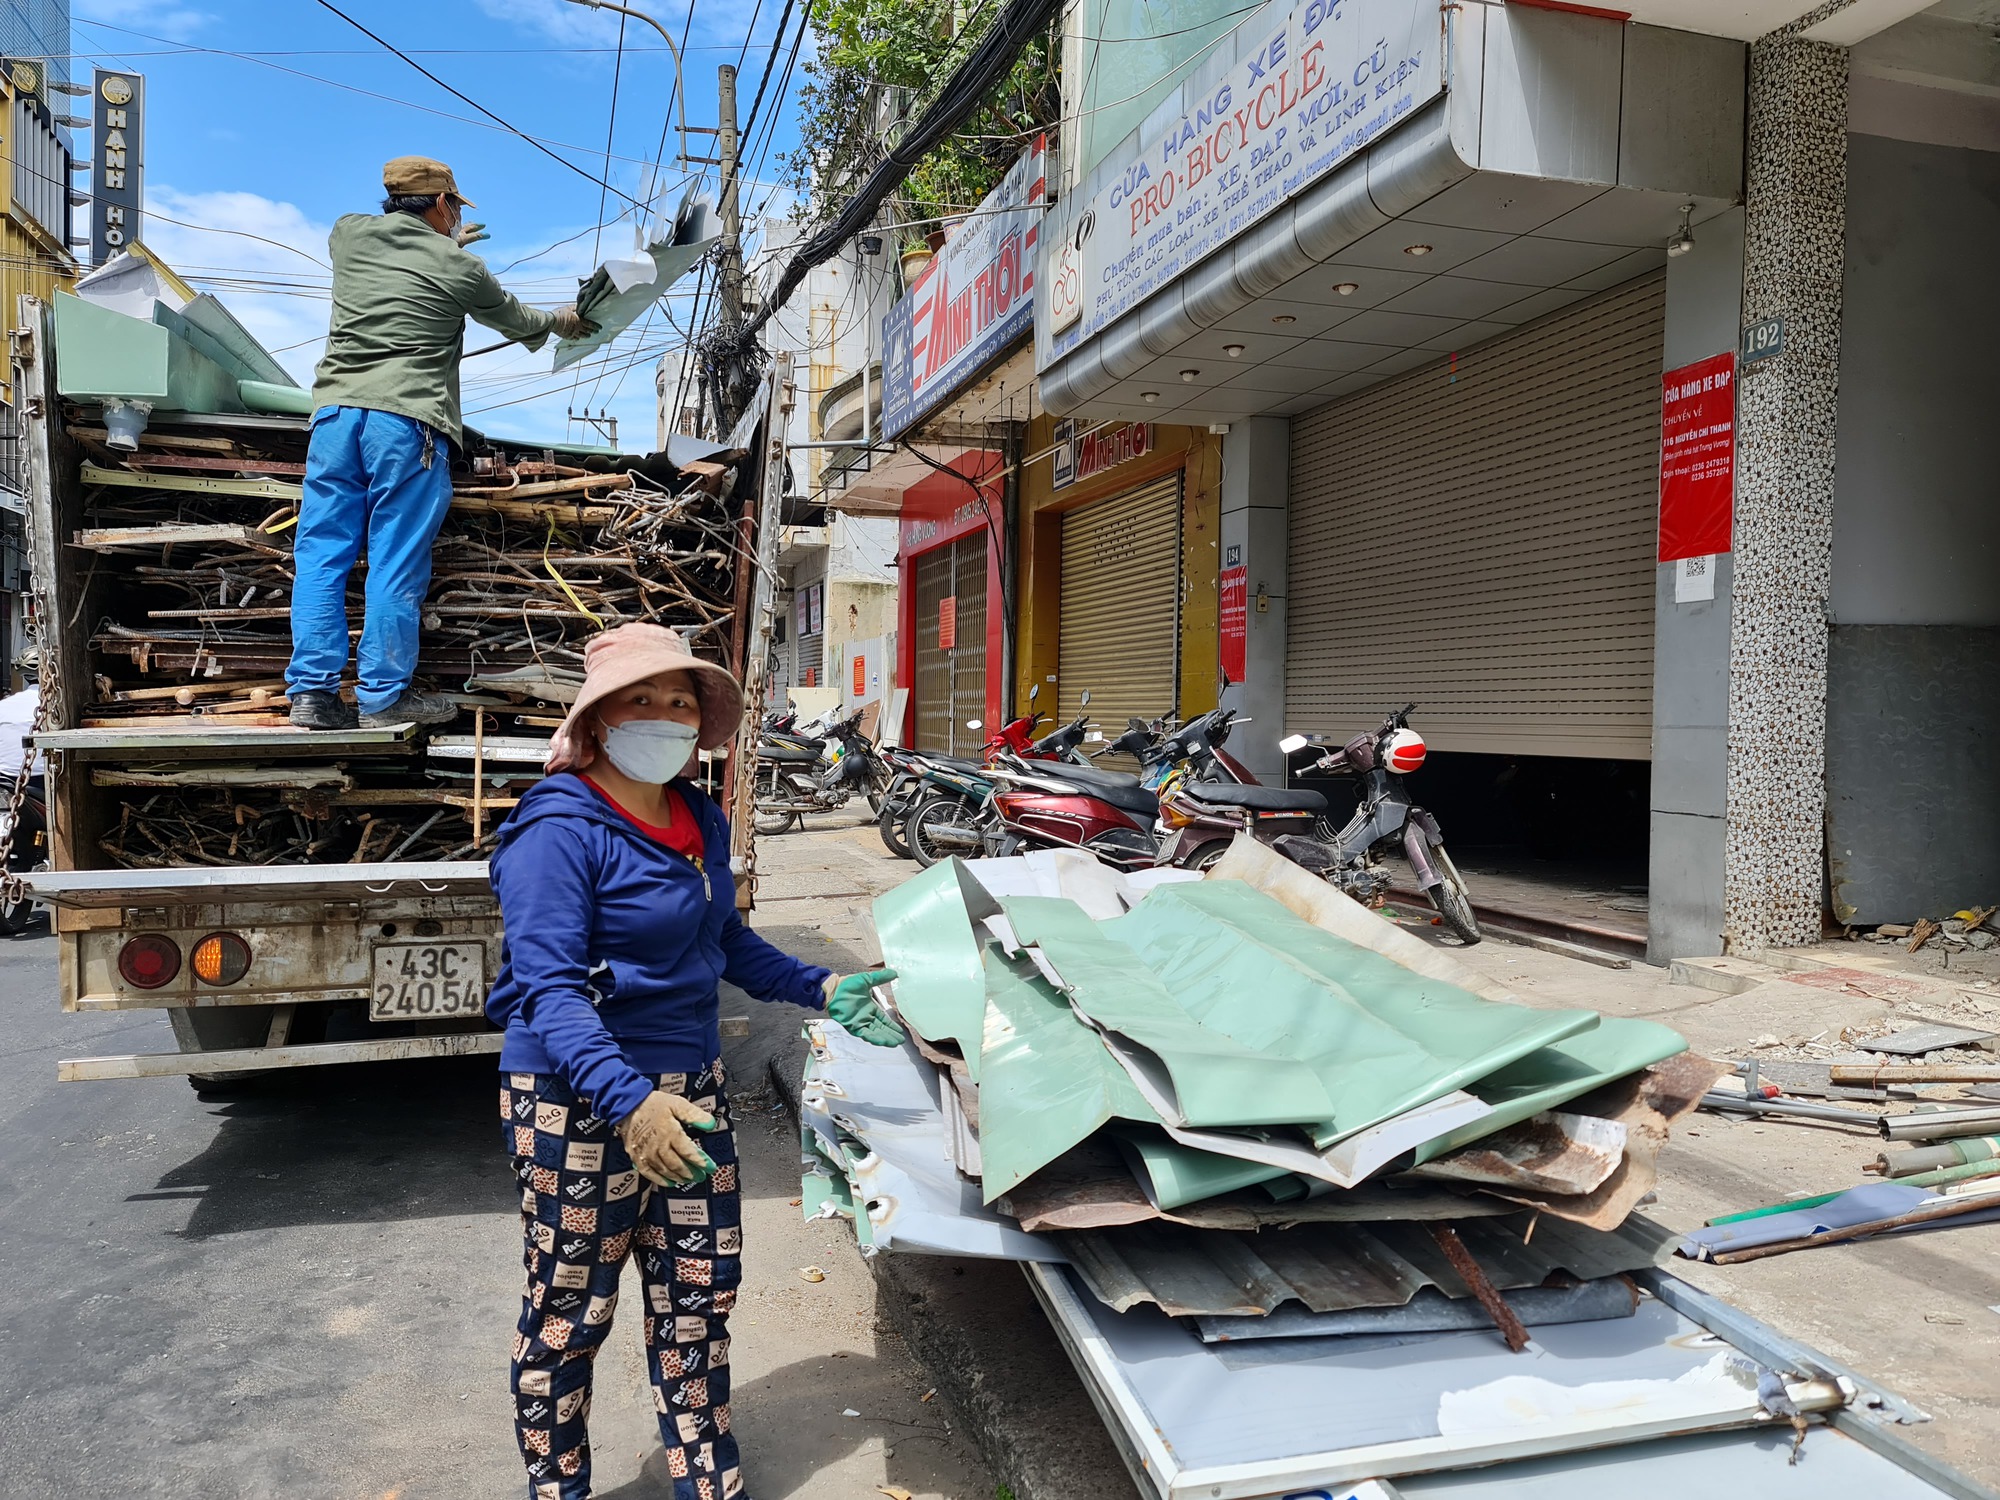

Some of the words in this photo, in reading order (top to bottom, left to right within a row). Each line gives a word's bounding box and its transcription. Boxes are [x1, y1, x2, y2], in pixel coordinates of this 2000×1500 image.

[1110, 161, 1150, 209] CỬA
[1164, 85, 1232, 163] HÀNG
[1248, 28, 1287, 89] XE
[105, 108, 127, 190] HẠNH
[1169, 225, 1194, 253] LOẠI
[1254, 152, 1293, 188] THAO
[1300, 129, 1317, 153] VÀ
[1325, 93, 1367, 138] LINH
[1148, 222, 1173, 250] mua
[1217, 163, 1242, 196] XE
[1250, 126, 1287, 170] ĐẠP
[923, 270, 973, 386] MINH
[1747, 322, 1780, 353] 192
[1665, 384, 1679, 404] CỬA
[1681, 380, 1701, 399] HÀNG
[1703, 375, 1713, 392] XE
[1715, 370, 1731, 390] ĐẠP
[1663, 437, 1674, 447] 116
[1710, 421, 1731, 434] THANH
[1705, 456, 1730, 469] 2479318
[1228, 548, 1239, 563] 194
[400, 947, 459, 980] 43C
[376, 980, 480, 1016] 240.54
[538, 1108, 561, 1125] D&G
[566, 1178, 591, 1196] R&C
[574, 1185, 597, 1200] FASHION
[562, 1239, 586, 1255] R&C
[676, 1230, 703, 1250] R&C
[551, 1292, 577, 1307] R&C
[678, 1291, 701, 1307] R&C
[523, 1401, 543, 1419] R&C
